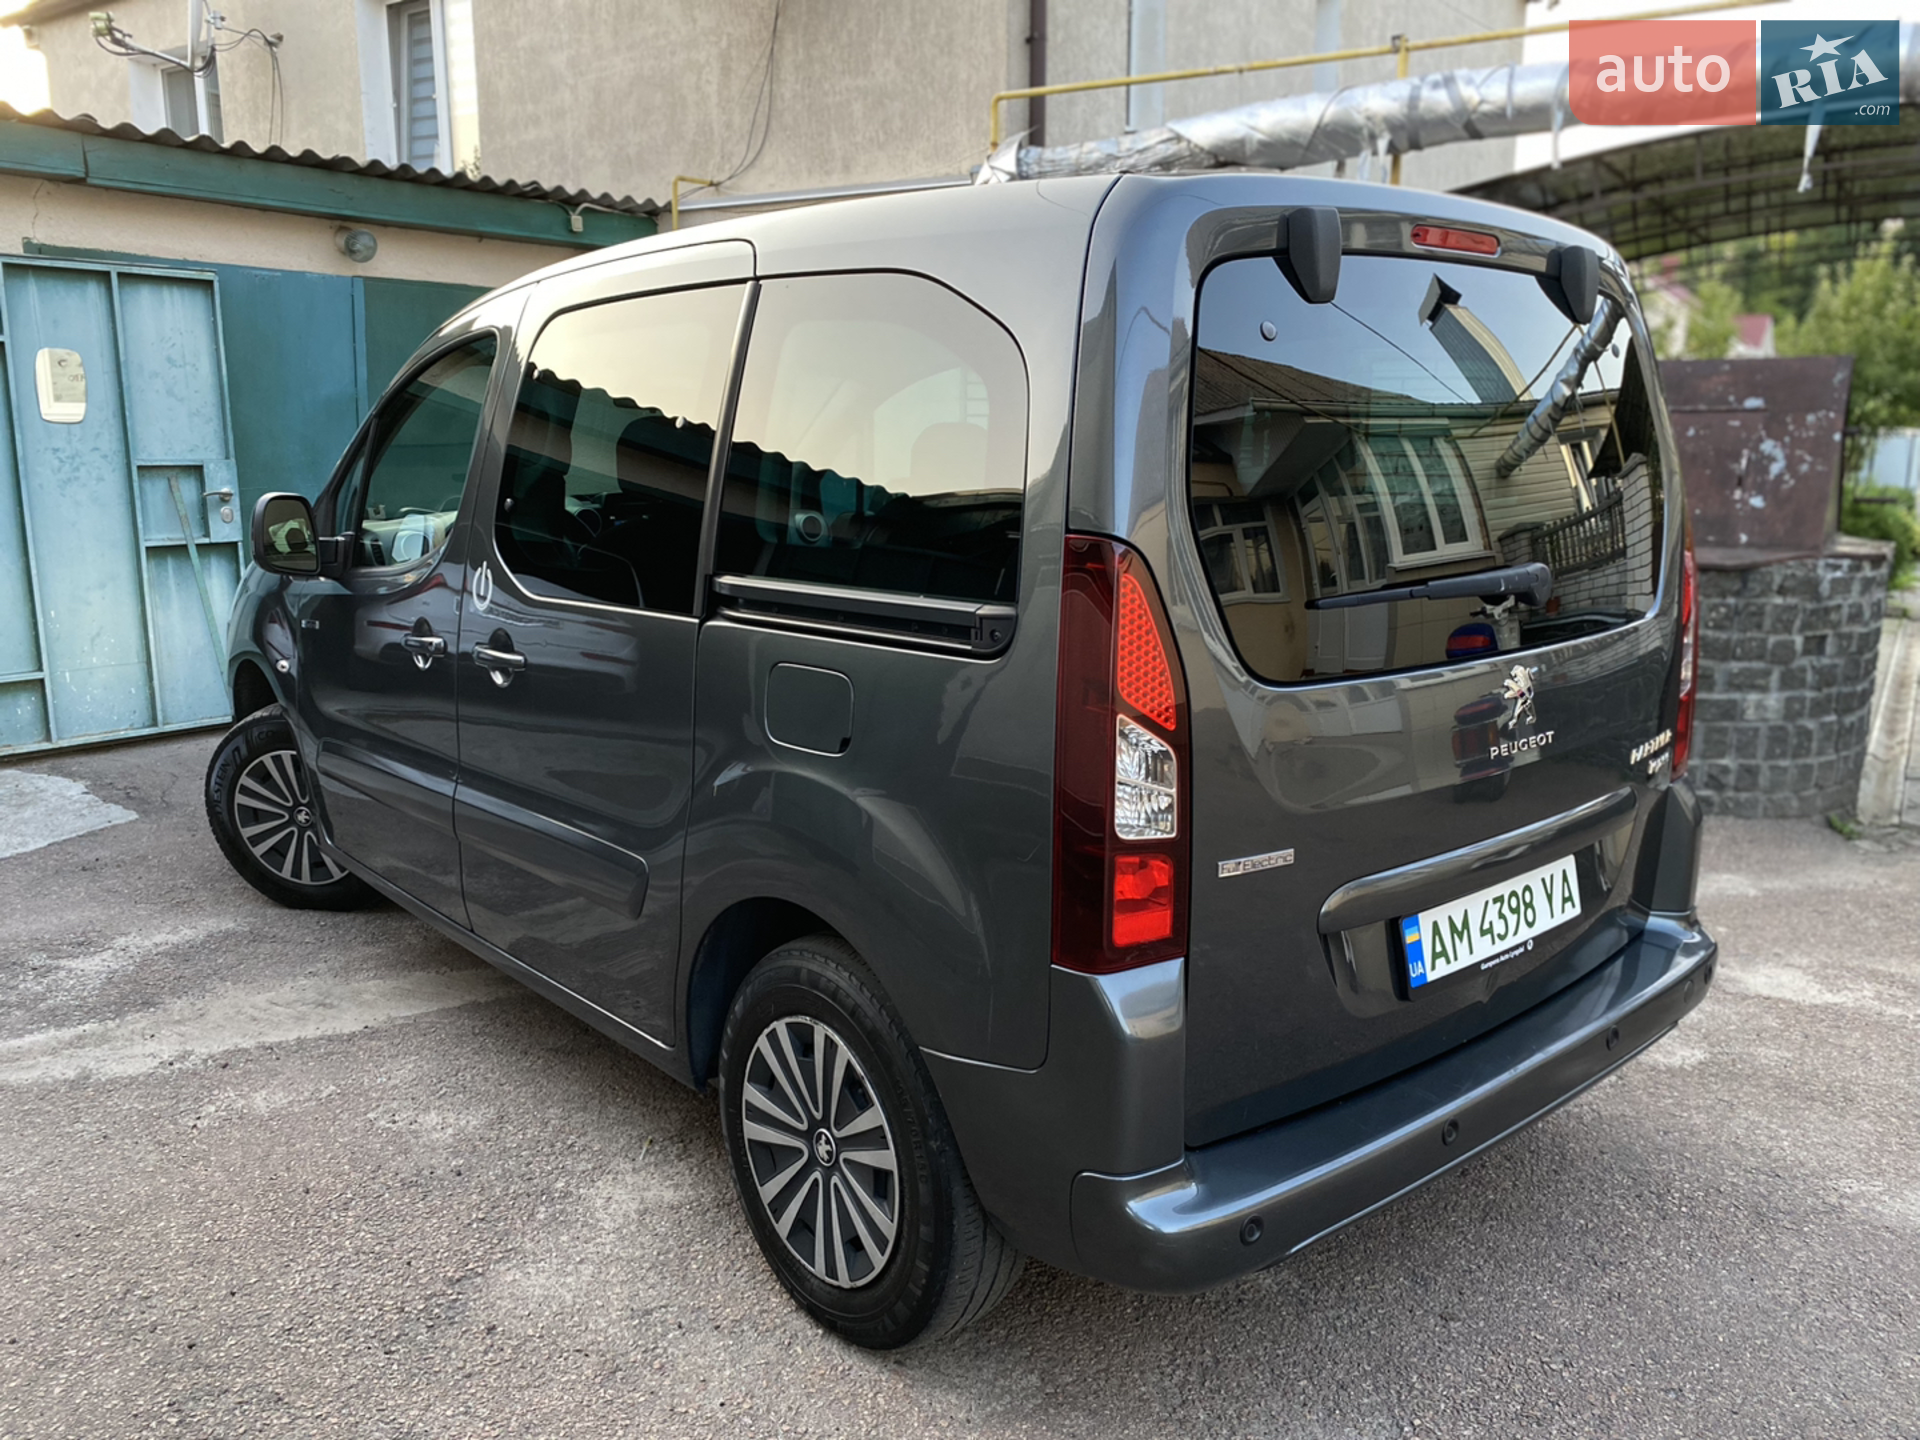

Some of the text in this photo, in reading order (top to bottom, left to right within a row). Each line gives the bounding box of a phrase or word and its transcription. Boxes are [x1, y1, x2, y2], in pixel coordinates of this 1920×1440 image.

[1489, 730, 1555, 760] PEUGEOT
[1430, 908, 1474, 972] AM
[1479, 884, 1537, 946] 4398
[1540, 868, 1576, 919] YA
[1409, 960, 1425, 977] UA
